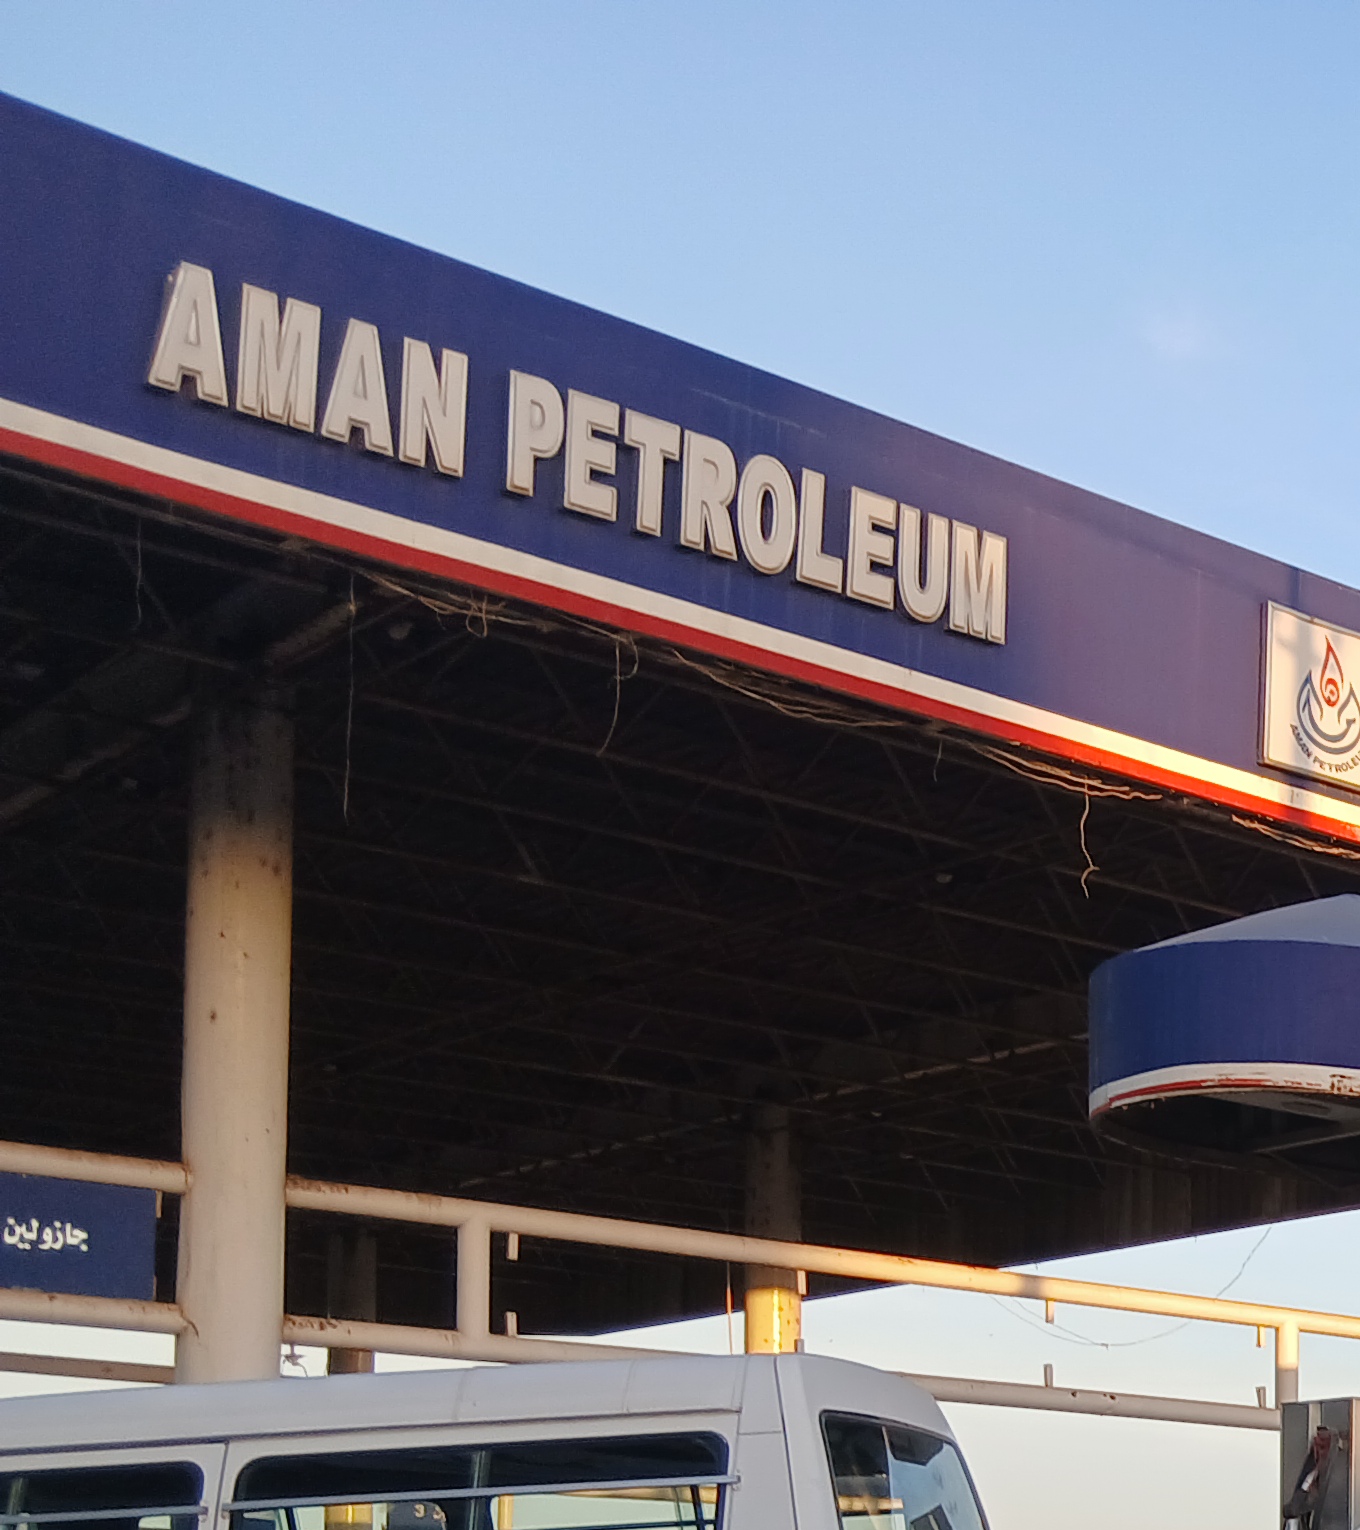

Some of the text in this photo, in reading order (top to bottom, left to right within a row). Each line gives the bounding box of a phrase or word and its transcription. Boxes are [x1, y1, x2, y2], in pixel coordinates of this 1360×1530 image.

[147, 261, 1008, 646] AMAN PETROLEUM
[1290, 723, 1313, 760] AMAN
[3, 1216, 89, 1253] جازولين
